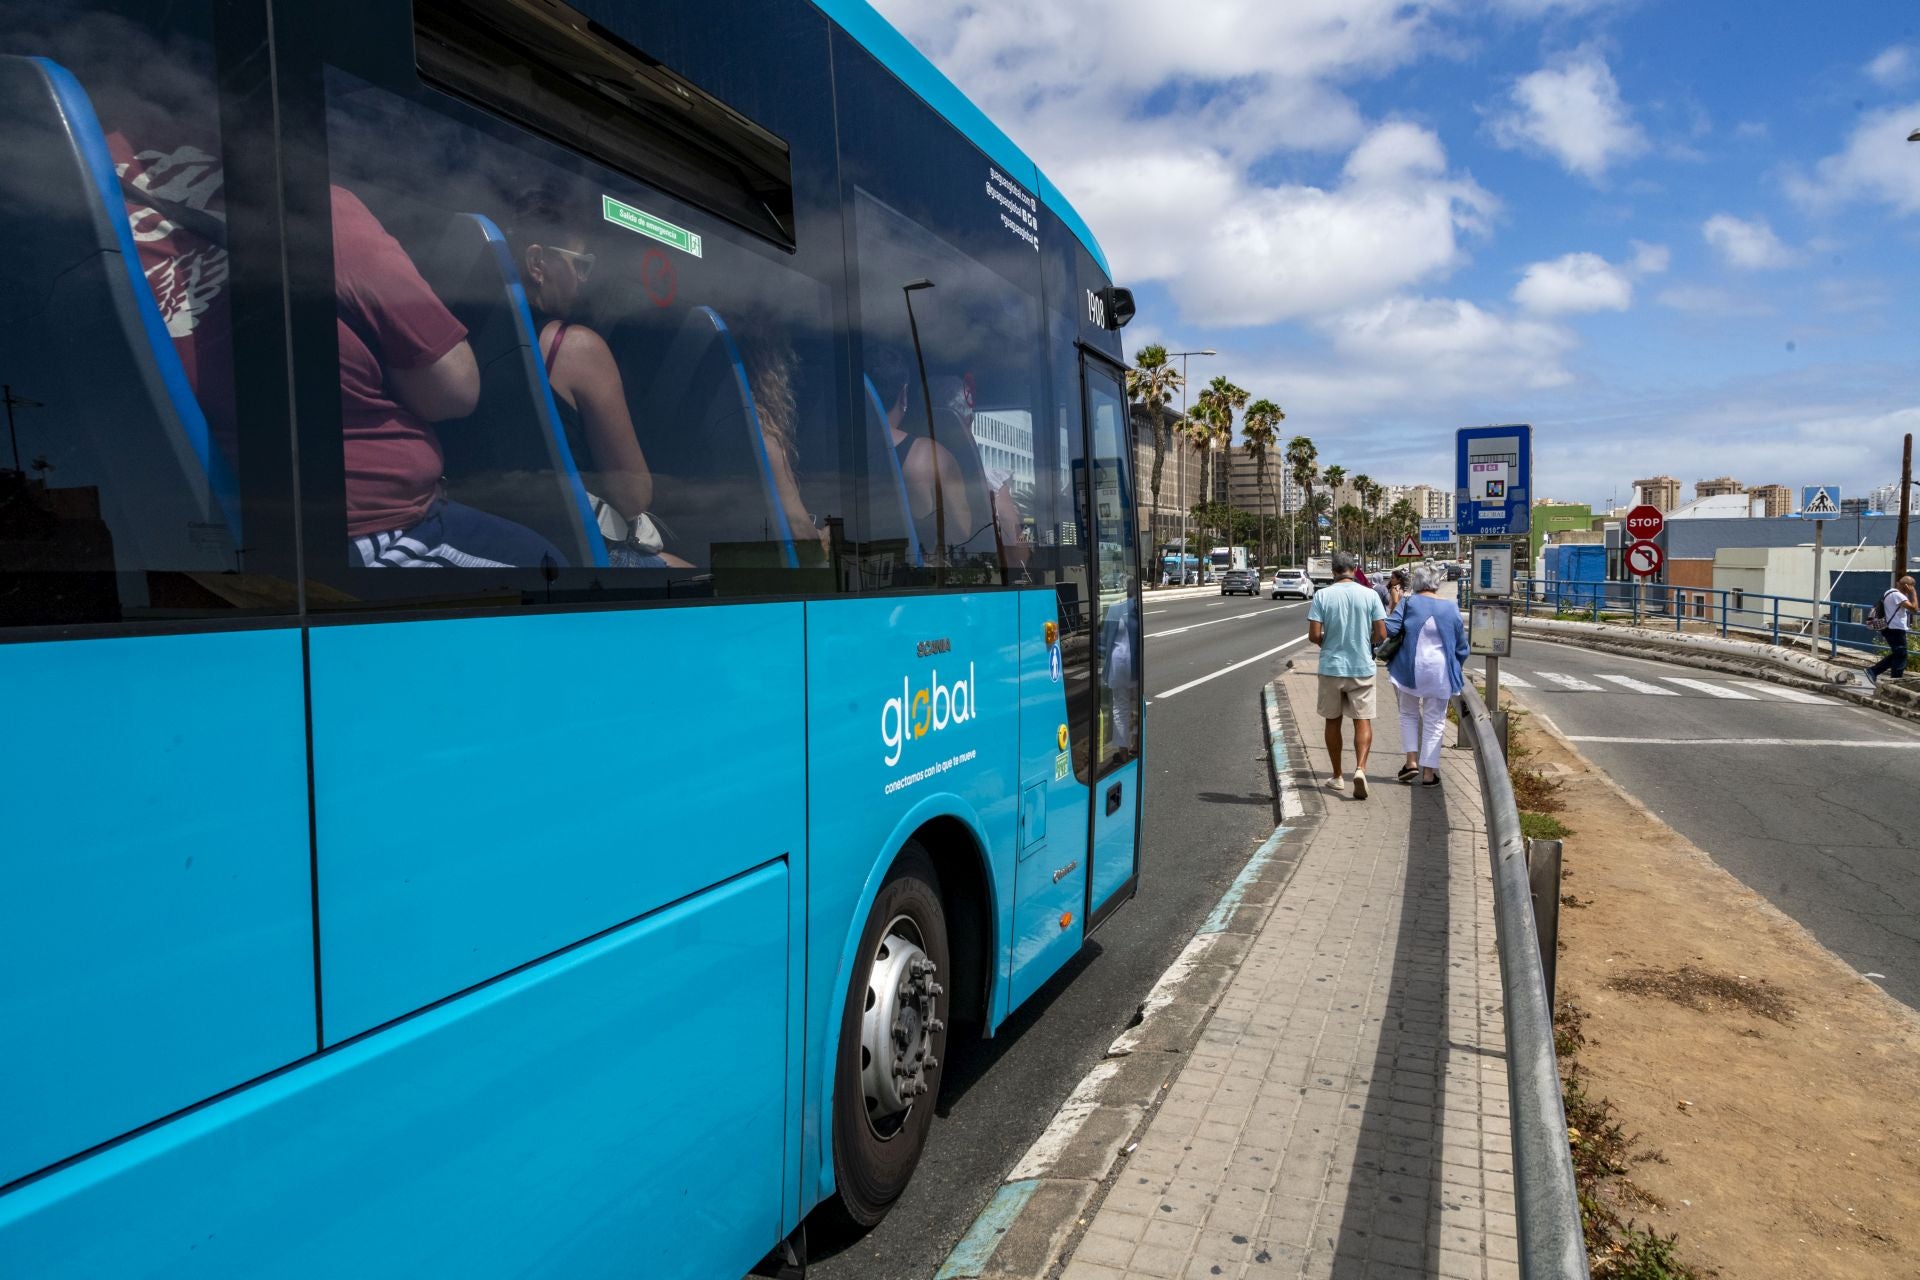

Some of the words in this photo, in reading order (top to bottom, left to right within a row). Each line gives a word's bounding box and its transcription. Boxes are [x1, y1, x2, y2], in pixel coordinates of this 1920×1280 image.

[619, 208, 638, 223] Salida
[638, 216, 646, 226] de
[646, 221, 677, 240] emergencia
[1087, 288, 1105, 329] 1908
[1629, 518, 1660, 527] STOP
[917, 638, 951, 657] SCANIA
[881, 661, 976, 767] global
[884, 769, 924, 795] conectamos
[924, 765, 935, 778] con
[935, 761, 942, 775] lo
[941, 758, 953, 773] que
[953, 755, 959, 766] te
[959, 749, 976, 763] mueve
